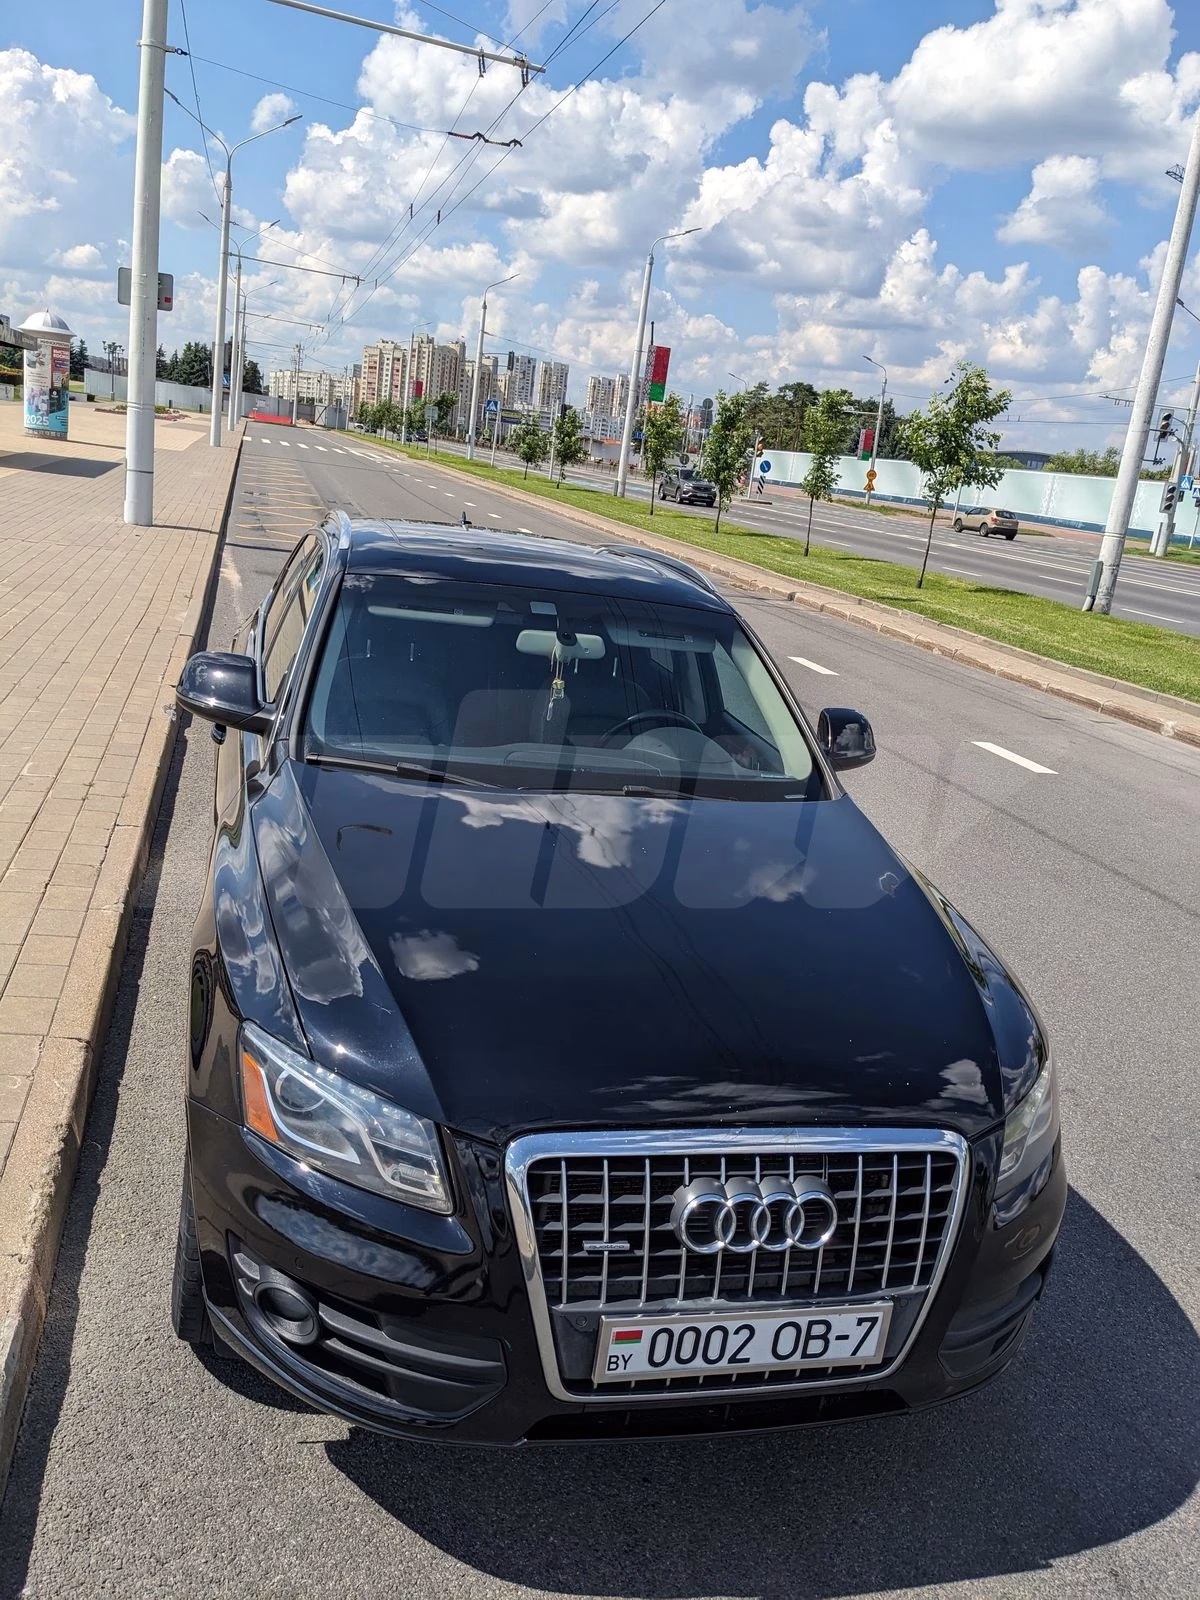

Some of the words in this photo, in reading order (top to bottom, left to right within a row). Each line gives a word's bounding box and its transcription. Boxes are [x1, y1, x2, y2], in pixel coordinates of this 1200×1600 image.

[26, 414, 49, 426] 2025
[648, 1323, 755, 1368] 0002
[771, 1316, 880, 1361] OB-7
[606, 1354, 633, 1372] BY
